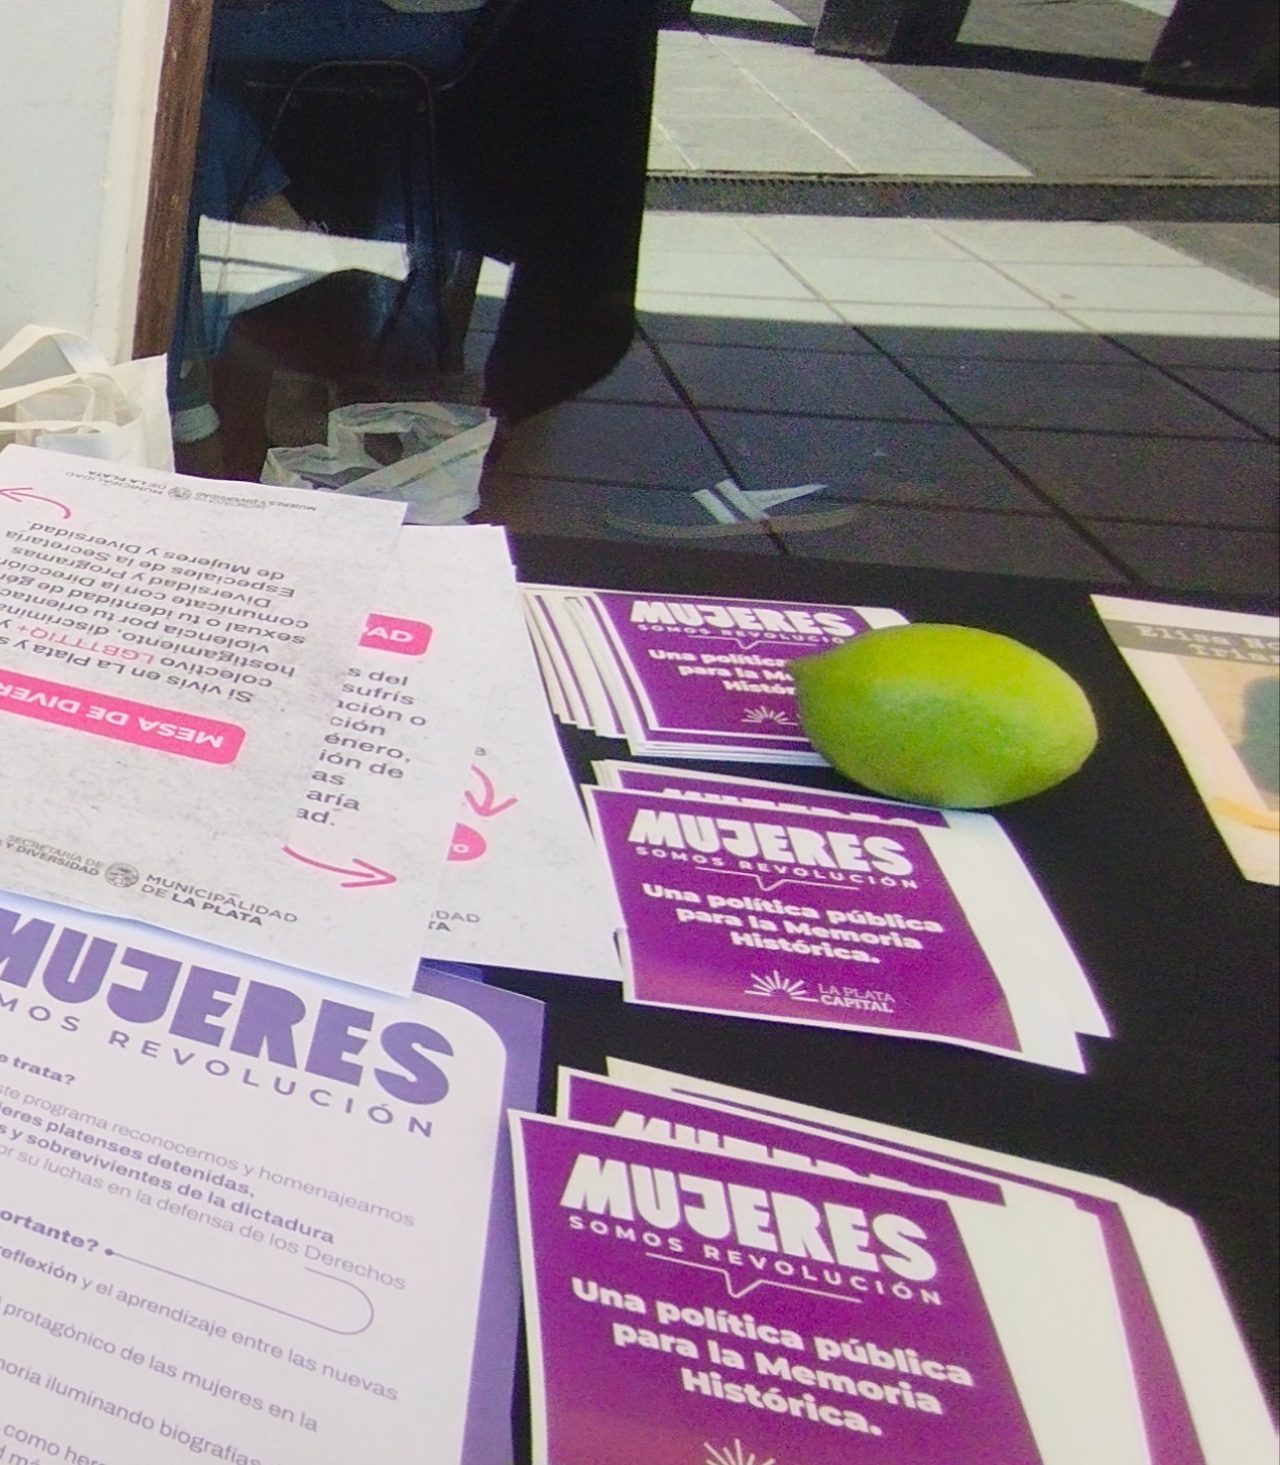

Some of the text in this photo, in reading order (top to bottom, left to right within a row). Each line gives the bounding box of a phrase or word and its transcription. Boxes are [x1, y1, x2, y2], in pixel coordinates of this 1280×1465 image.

[6, 530, 295, 598] Especiales de la Secretaría
[146, 547, 160, 556] y
[163, 551, 251, 575] Mujeres
[257, 569, 284, 581] de
[630, 601, 855, 637] MUJERES
[638, 624, 845, 644] SOMOS REVOLUCIÓ
[13, 639, 28, 649] y
[32, 643, 90, 667] Plata
[648, 649, 696, 662] Una
[96, 659, 126, 674] La
[131, 667, 160, 680] en
[160, 657, 272, 687] colectivo
[378, 670, 409, 686] del
[678, 664, 731, 679] para
[735, 668, 758, 679] la
[228, 689, 254, 703] Si
[342, 683, 415, 706] sufrís
[722, 680, 795, 696] Histór
[86, 705, 130, 726] DE
[138, 717, 224, 748] MESA
[323, 733, 411, 763] énero,
[5, 839, 14, 849] Y
[16, 841, 100, 876] DIVERSIDAD
[628, 809, 913, 876] MUJERES
[84, 856, 104, 868] DE
[636, 846, 919, 889] SOMOS REVOLUCIÓN
[141, 884, 263, 926] DE LA PLATA
[146, 874, 298, 923] MUNICIPALIDAD
[642, 883, 944, 933] Una política pública
[677, 908, 923, 949] para la Memoria
[730, 931, 881, 964] Histórica.
[818, 984, 896, 1003] LA PLATA
[820, 996, 894, 1014] CAPITAL
[12, 1053, 76, 1087] trata?
[109, 1030, 433, 1139] REVOLUCIÓN
[23, 1090, 108, 1130] programa
[112, 1123, 239, 1172] reconocemos
[243, 1161, 255, 1177] y
[259, 1167, 416, 1227] homenajeamos
[46, 1116, 142, 1161] platenses
[146, 1152, 255, 1198] detenidas,
[9, 1125, 24, 1142] y
[26, 1130, 172, 1191] sobrevivientes
[178, 1180, 204, 1201] de
[208, 1191, 226, 1209] la
[230, 1200, 336, 1245] dictadura
[559, 1154, 938, 1282] MUJERES
[569, 1215, 943, 1306] SOMOS REVOLUCIÓN
[572, 1277, 974, 1387] Una política pública
[612, 1323, 944, 1415] para la Memoria
[681, 1368, 883, 1436] Histórica.
